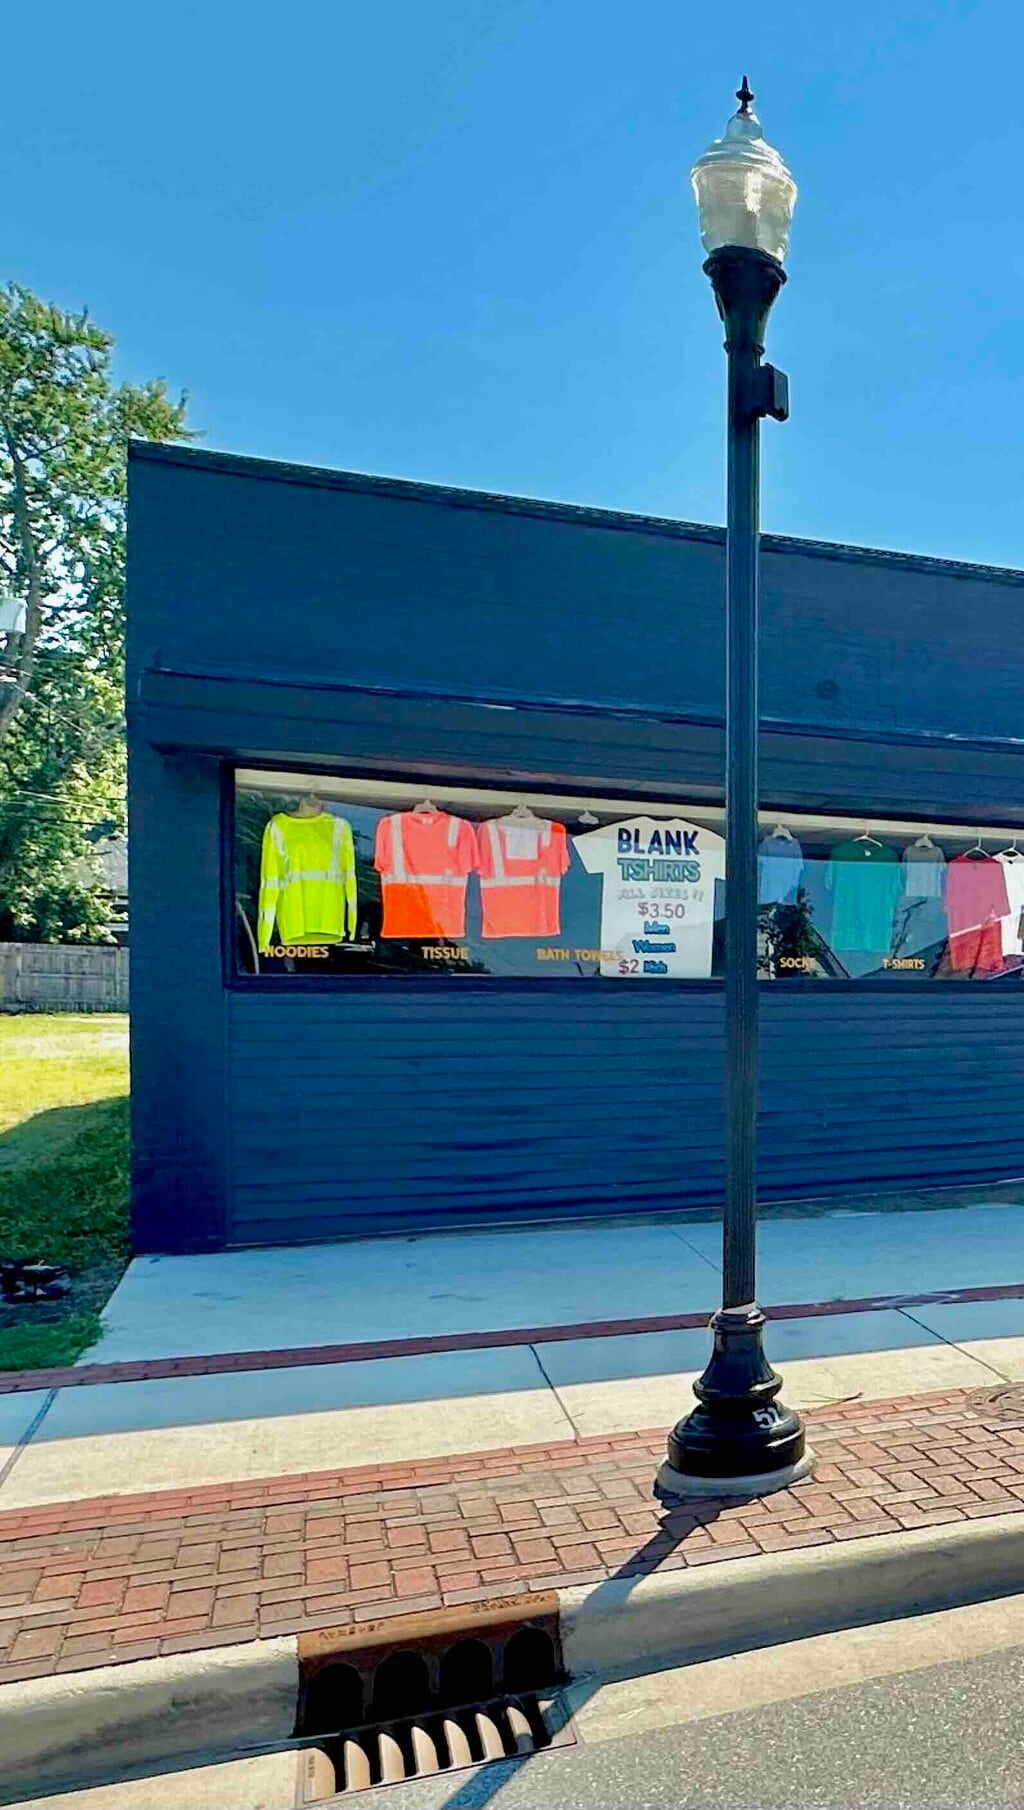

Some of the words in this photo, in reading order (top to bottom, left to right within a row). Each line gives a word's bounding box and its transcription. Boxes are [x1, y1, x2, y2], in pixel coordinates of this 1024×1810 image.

[617, 828, 700, 855] BLANK
[617, 858, 701, 883] TSHIRTS
[638, 902, 685, 918] $3.50
[644, 921, 670, 934] Men
[264, 946, 329, 958] HOODIES
[421, 946, 469, 960] TISSUE
[632, 940, 676, 953] Women
[536, 948, 569, 961] BATH
[575, 949, 624, 961] TOWELS
[619, 959, 639, 974] $2
[882, 958, 926, 970] T-SHIRTS
